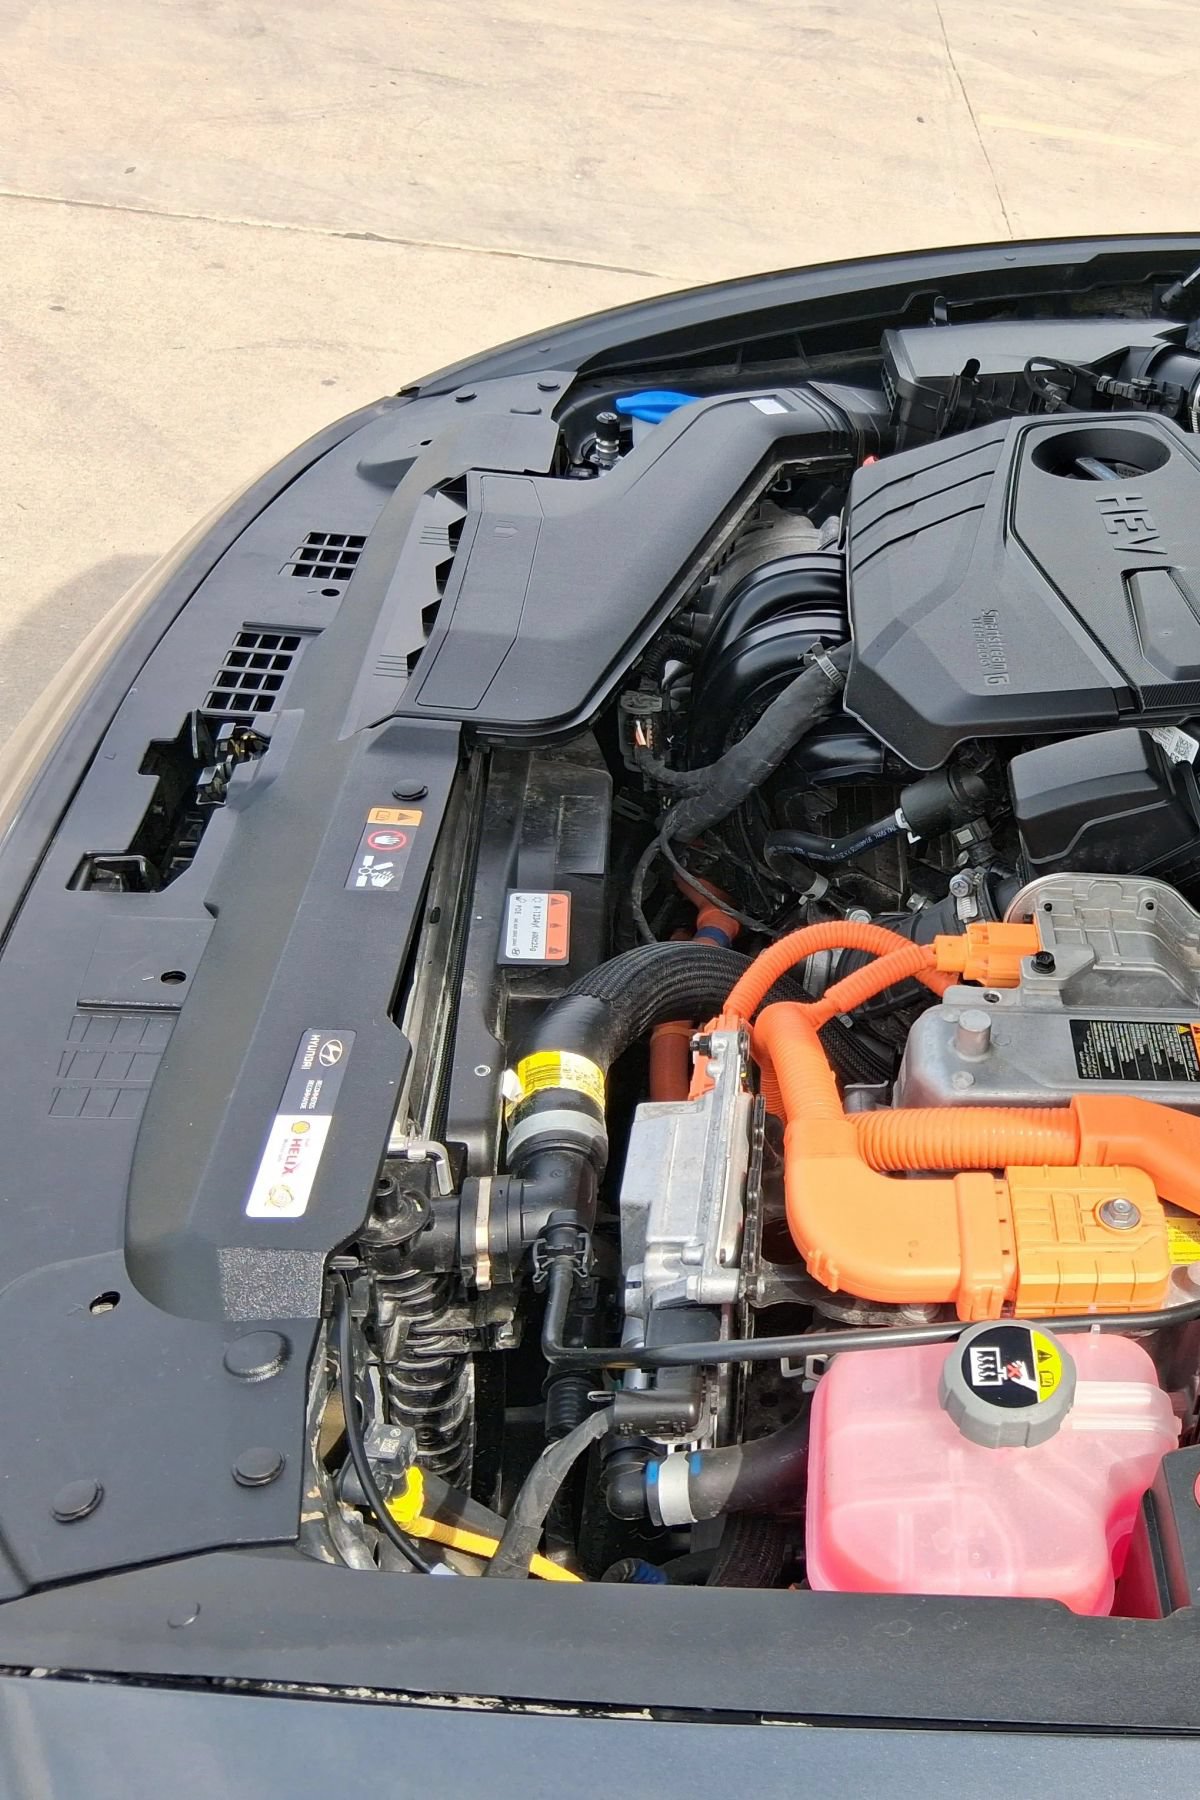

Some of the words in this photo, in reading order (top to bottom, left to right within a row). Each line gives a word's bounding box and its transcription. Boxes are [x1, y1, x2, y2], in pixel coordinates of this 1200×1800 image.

[1095, 493, 1168, 555] HEV
[971, 617, 992, 669] TECHNOLOGY
[981, 609, 1007, 671] Smartstream
[300, 1034, 320, 1070] HYUNDAI
[281, 1138, 303, 1175] HELIX
